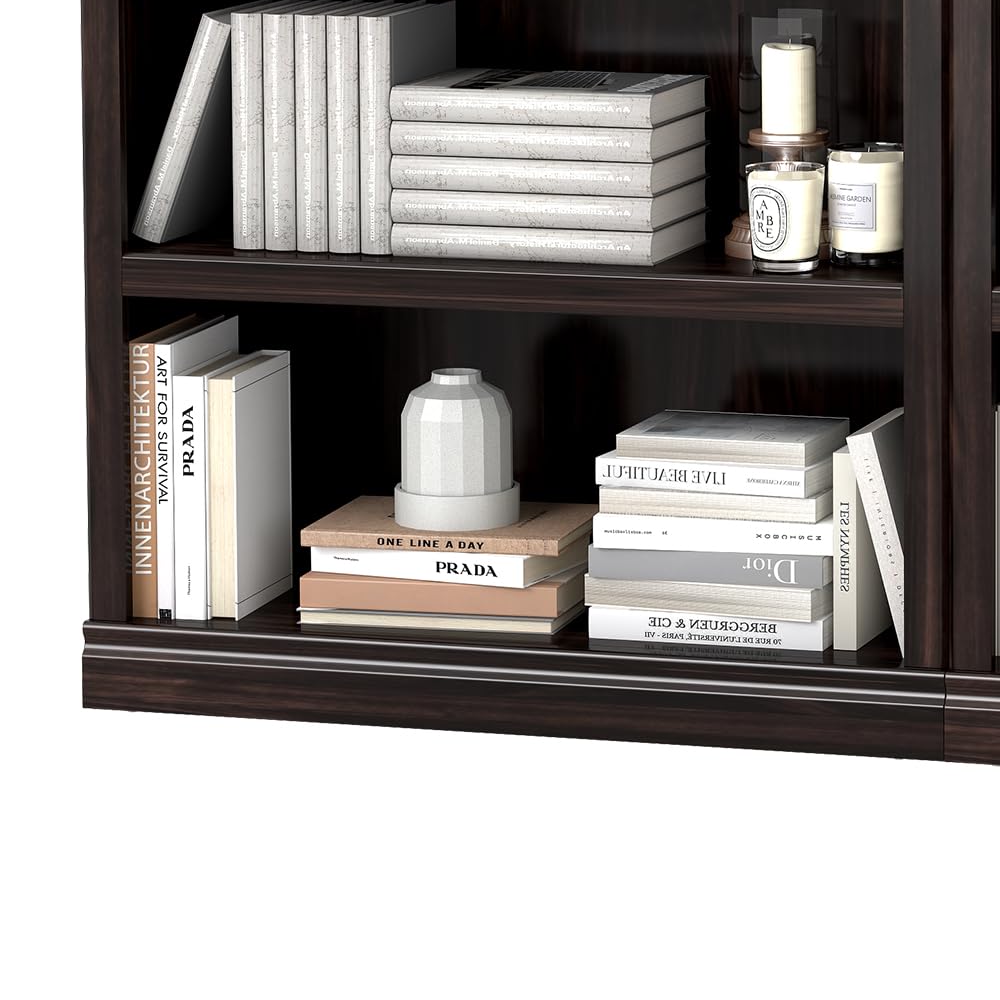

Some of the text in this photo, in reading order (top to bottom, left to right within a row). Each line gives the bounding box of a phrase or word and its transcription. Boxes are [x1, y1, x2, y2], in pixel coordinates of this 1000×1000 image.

[846, 195, 872, 203] GARDEN
[156, 355, 169, 505] ART FOR SURVIVAL
[182, 405, 195, 477] PRADA
[132, 342, 152, 575] INNENARCHITEKTUR
[376, 537, 485, 550] ONE LINE A DAY
[435, 560, 498, 578] PRADA
[742, 557, 800, 585] Dior
